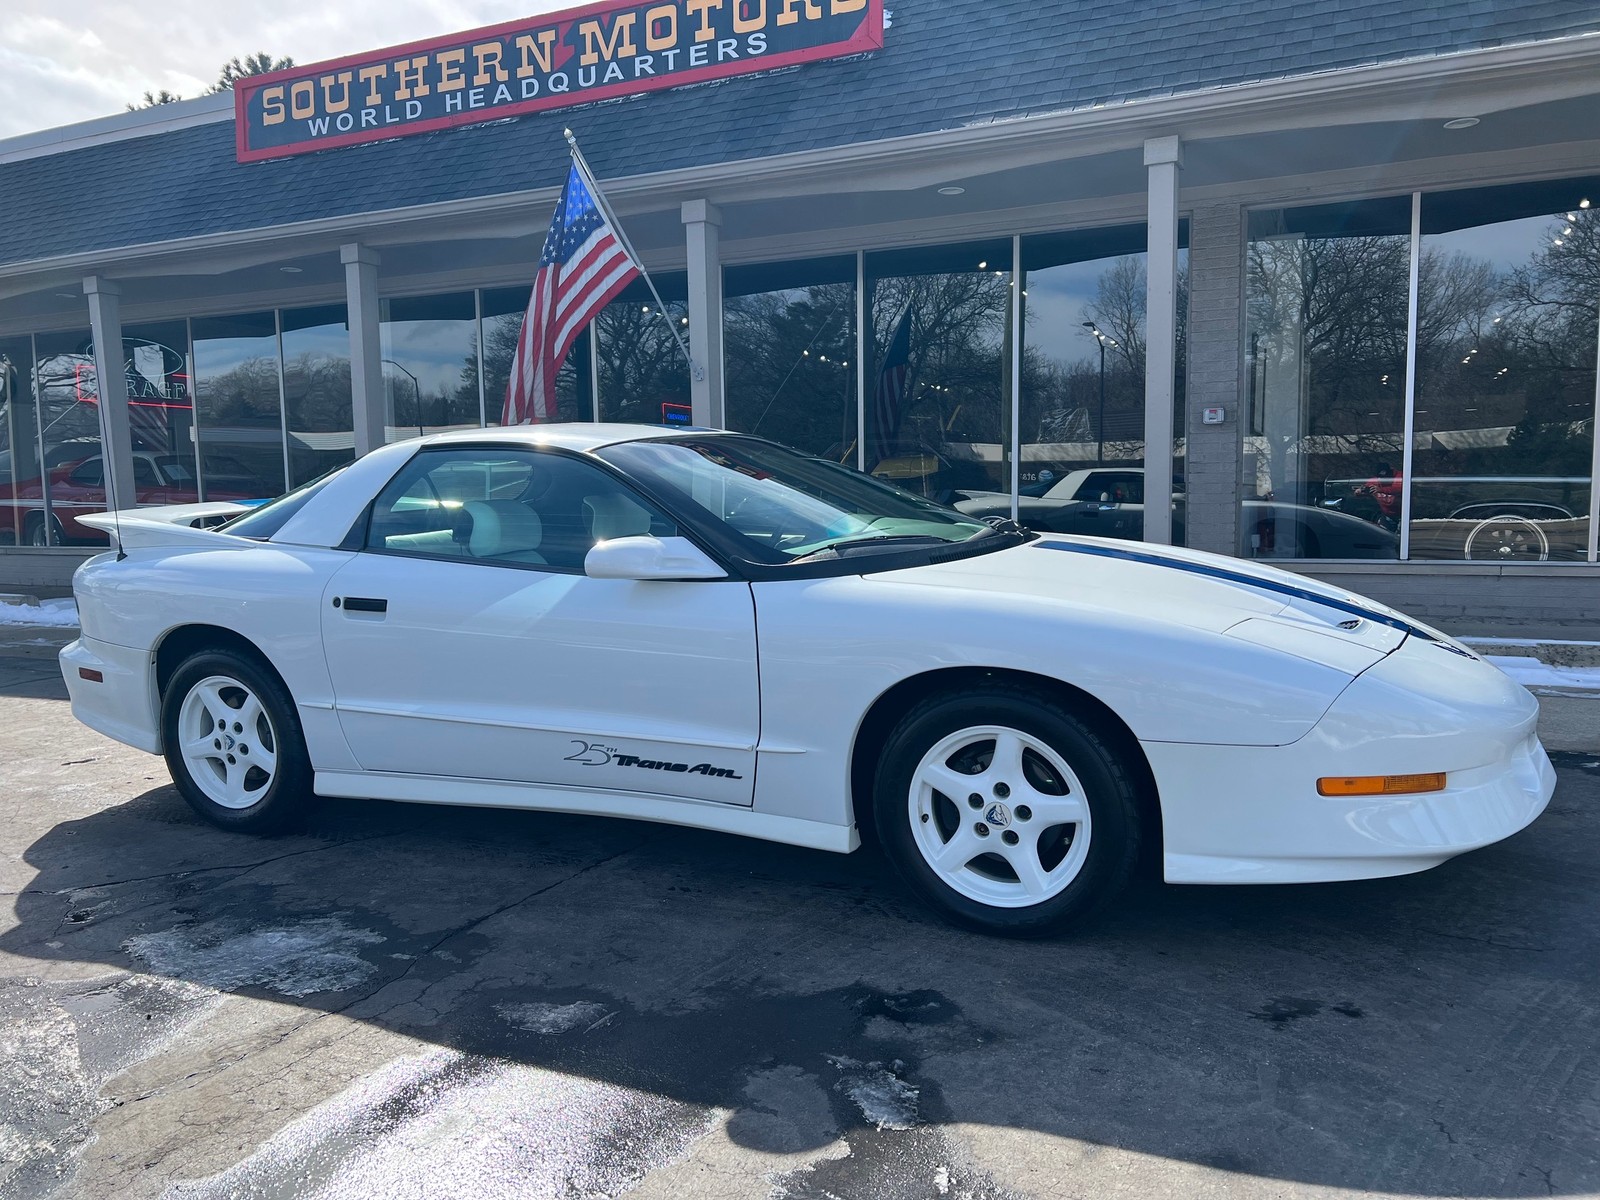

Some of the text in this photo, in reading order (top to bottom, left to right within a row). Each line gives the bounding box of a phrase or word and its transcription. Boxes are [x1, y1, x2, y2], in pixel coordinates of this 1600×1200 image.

[262, 29, 557, 126] SOUTHERN
[307, 33, 768, 137] WORLD HEADQUARTERS
